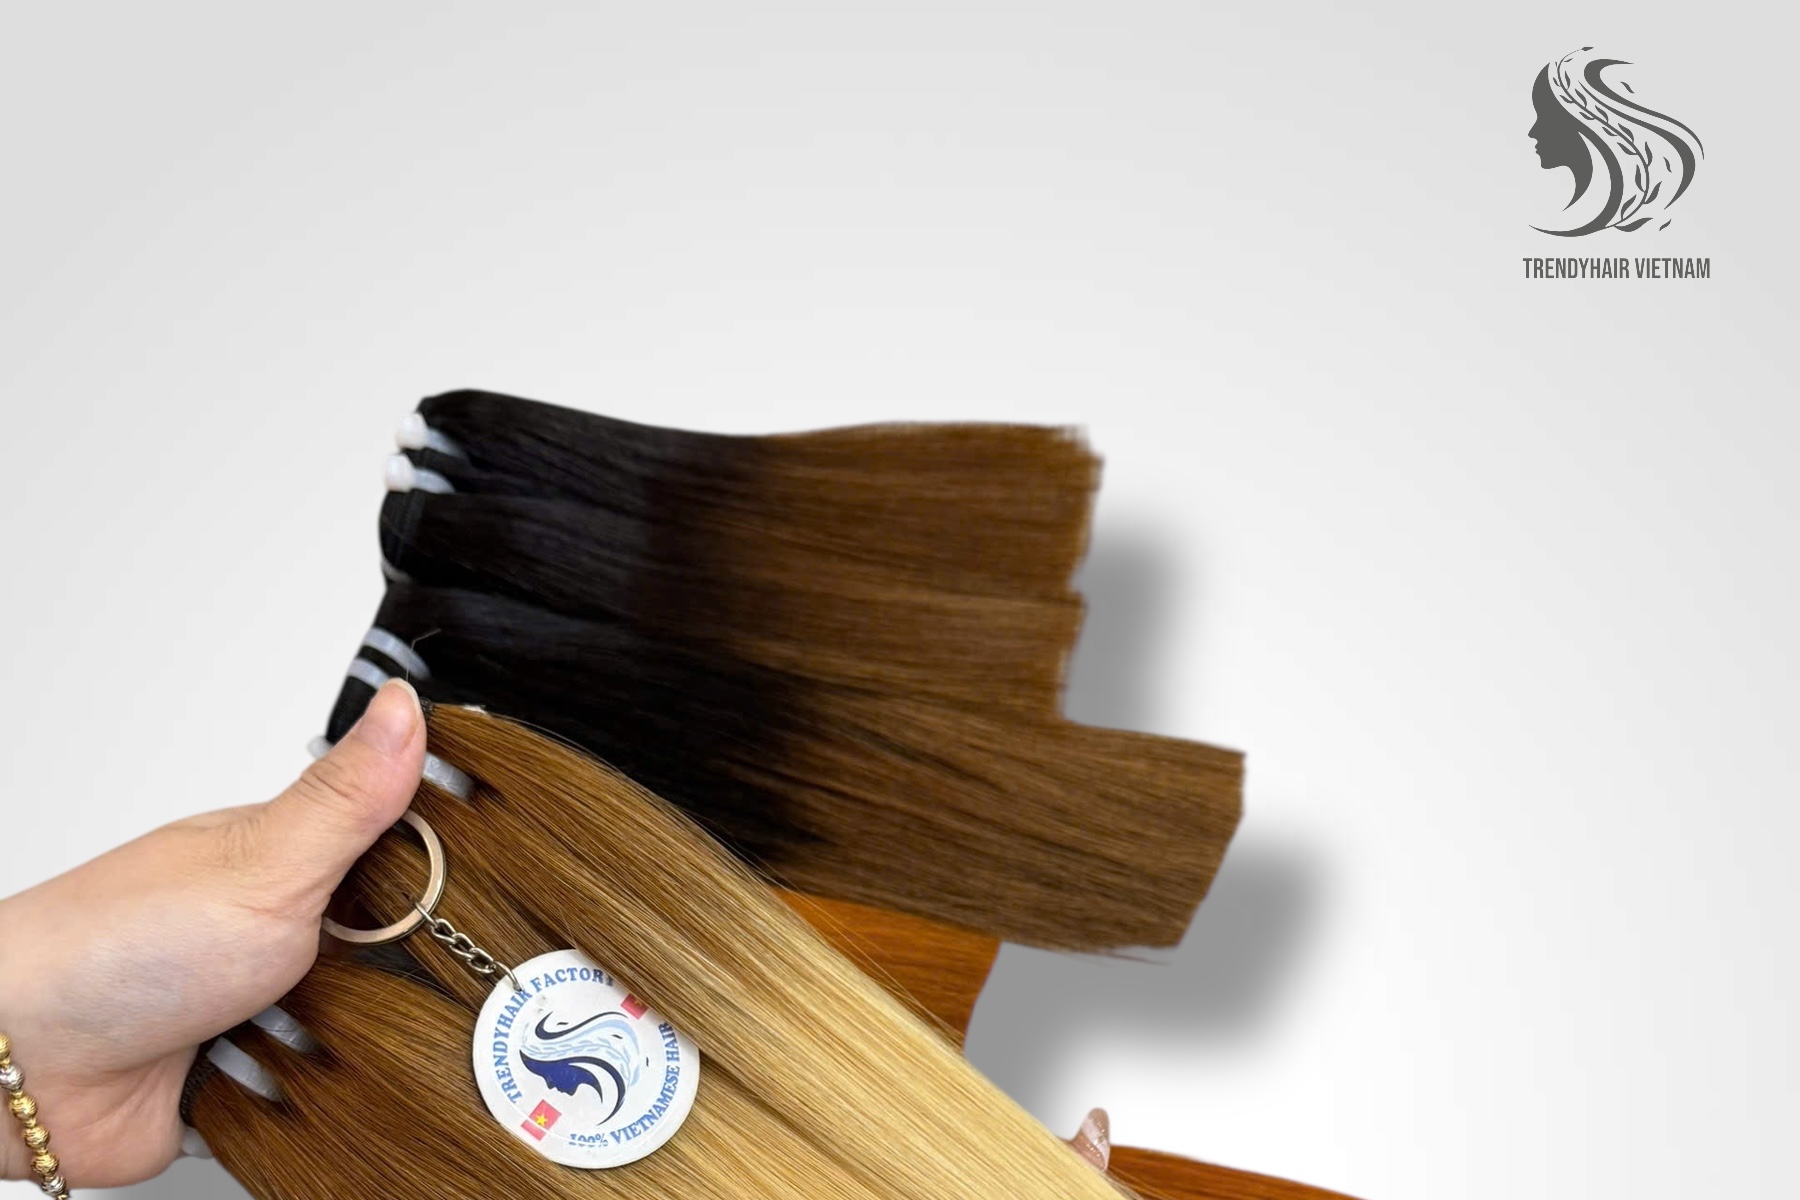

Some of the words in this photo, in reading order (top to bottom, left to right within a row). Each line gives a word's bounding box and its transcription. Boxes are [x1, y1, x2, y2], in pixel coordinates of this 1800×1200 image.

[493, 989, 533, 1104] TRENDYHAIR
[568, 1133, 609, 1148] 100%
[609, 1065, 680, 1144] VIETNAMESE
[658, 1022, 680, 1062] HAIR
